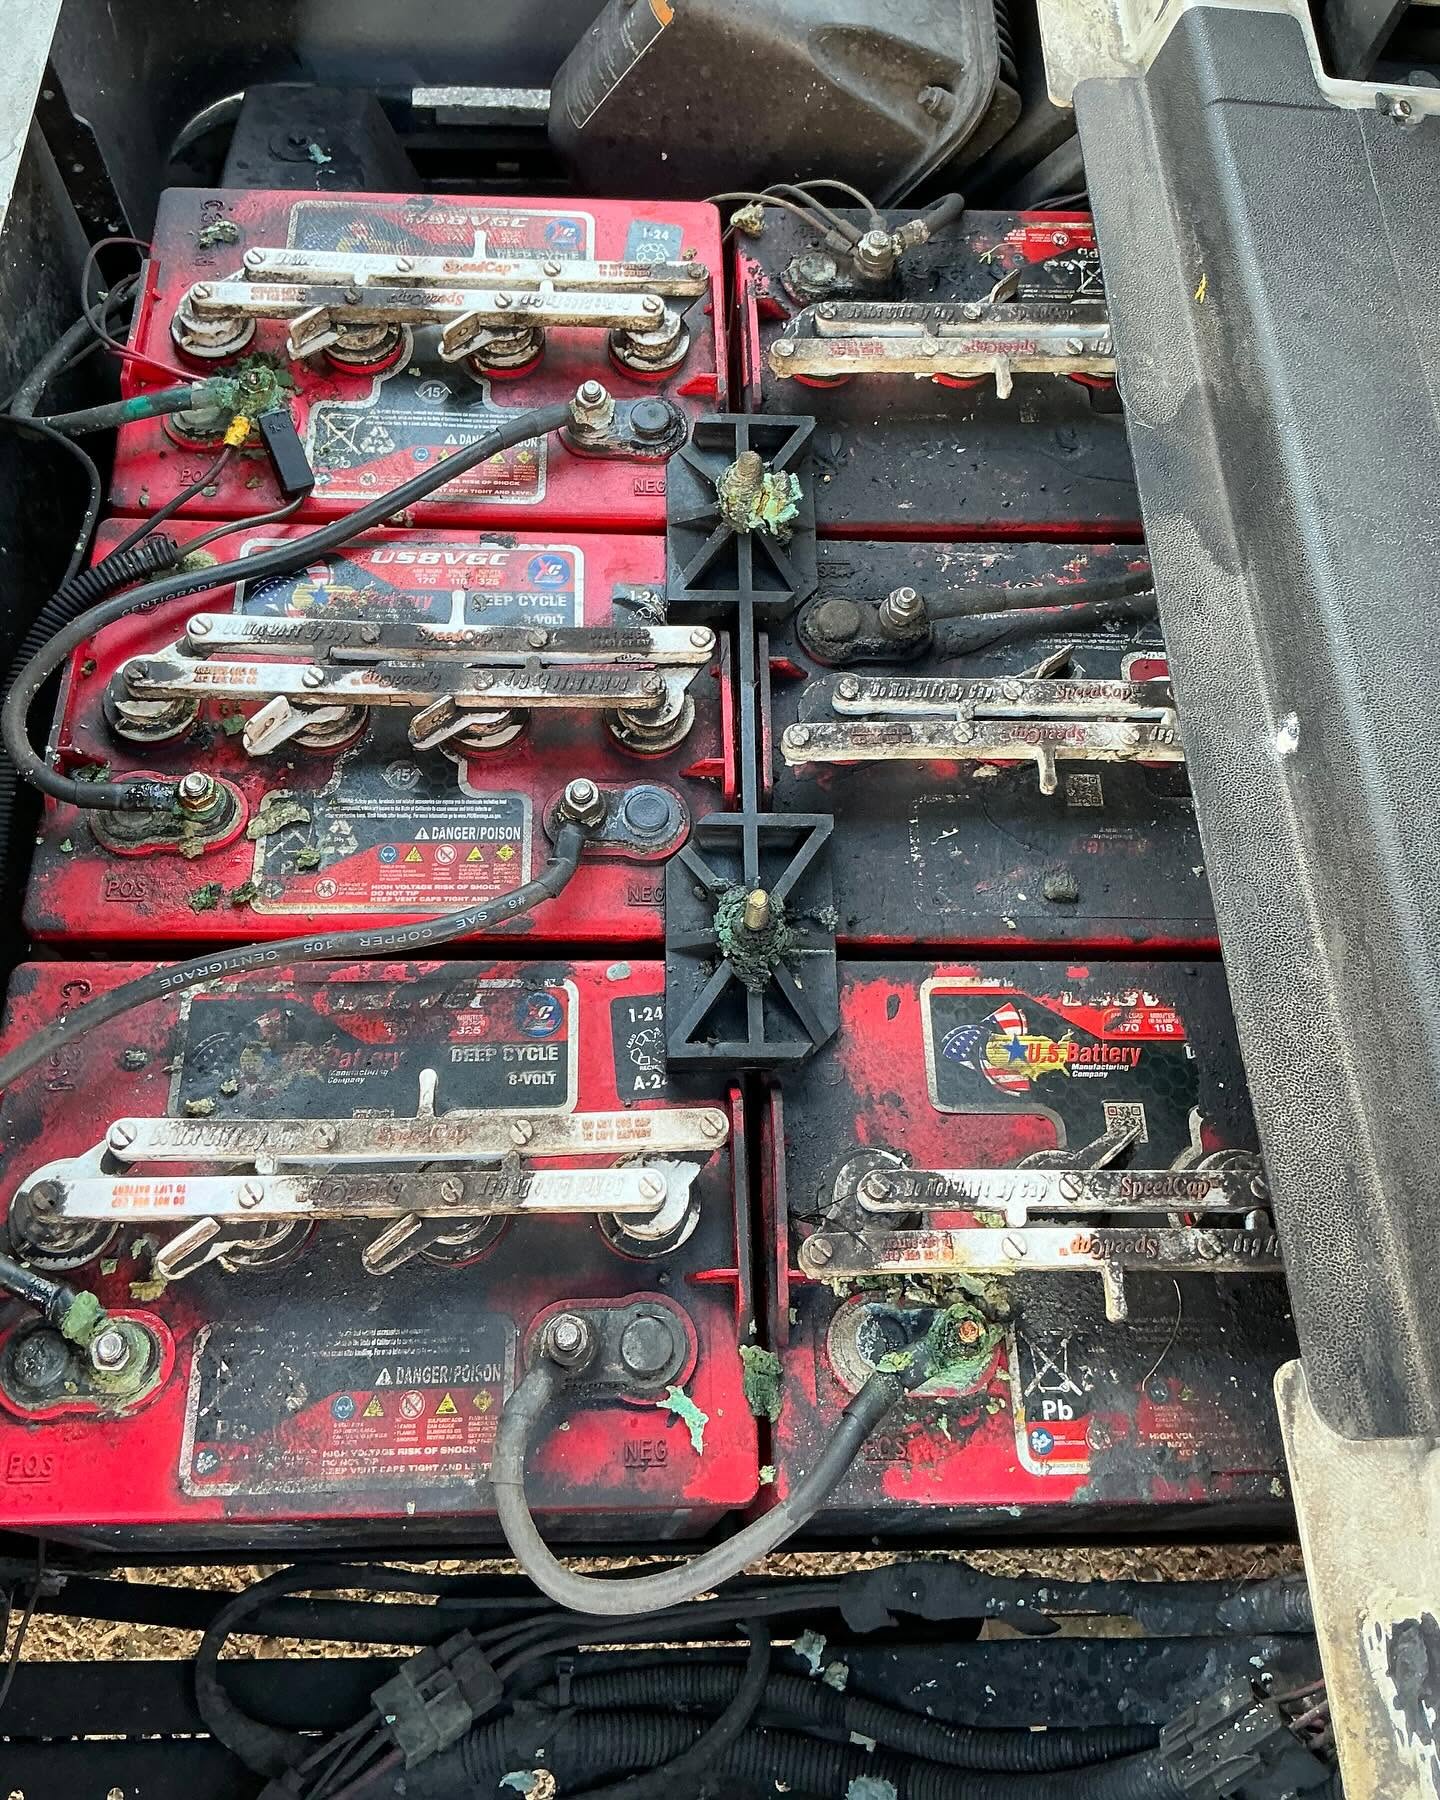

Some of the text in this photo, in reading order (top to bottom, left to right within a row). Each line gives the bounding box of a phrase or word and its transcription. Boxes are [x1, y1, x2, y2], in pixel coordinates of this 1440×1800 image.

[642, 227, 670, 241] 1-24
[426, 386, 441, 398] 15
[370, 550, 511, 566] US8VGC
[518, 595, 567, 607] CYCLE
[432, 827, 521, 841] DANGER/POISON
[105, 878, 148, 898] POS
[627, 884, 665, 903] NEG
[456, 911, 488, 929] SAE
[360, 928, 433, 947] COPPER
[303, 939, 334, 953] 105
[159, 950, 279, 990] CENTIGRADE
[628, 1006, 663, 1022] 1-24
[1154, 1024, 1175, 1032] 118
[451, 1046, 559, 1063] DEEP CYCLE
[1027, 1042, 1142, 1068] U.S. Battery
[1071, 1063, 1130, 1072] Manufacturing
[1072, 1071, 1109, 1079] Company
[508, 1072, 557, 1086] 8-VOLT
[1042, 1400, 1074, 1421] Pb
[397, 1447, 422, 1456] RISK
[424, 1446, 438, 1455] OF
[440, 1446, 477, 1455] SHOCK
[624, 1440, 667, 1461] NEG
[408, 1464, 439, 1472] TIGHT
